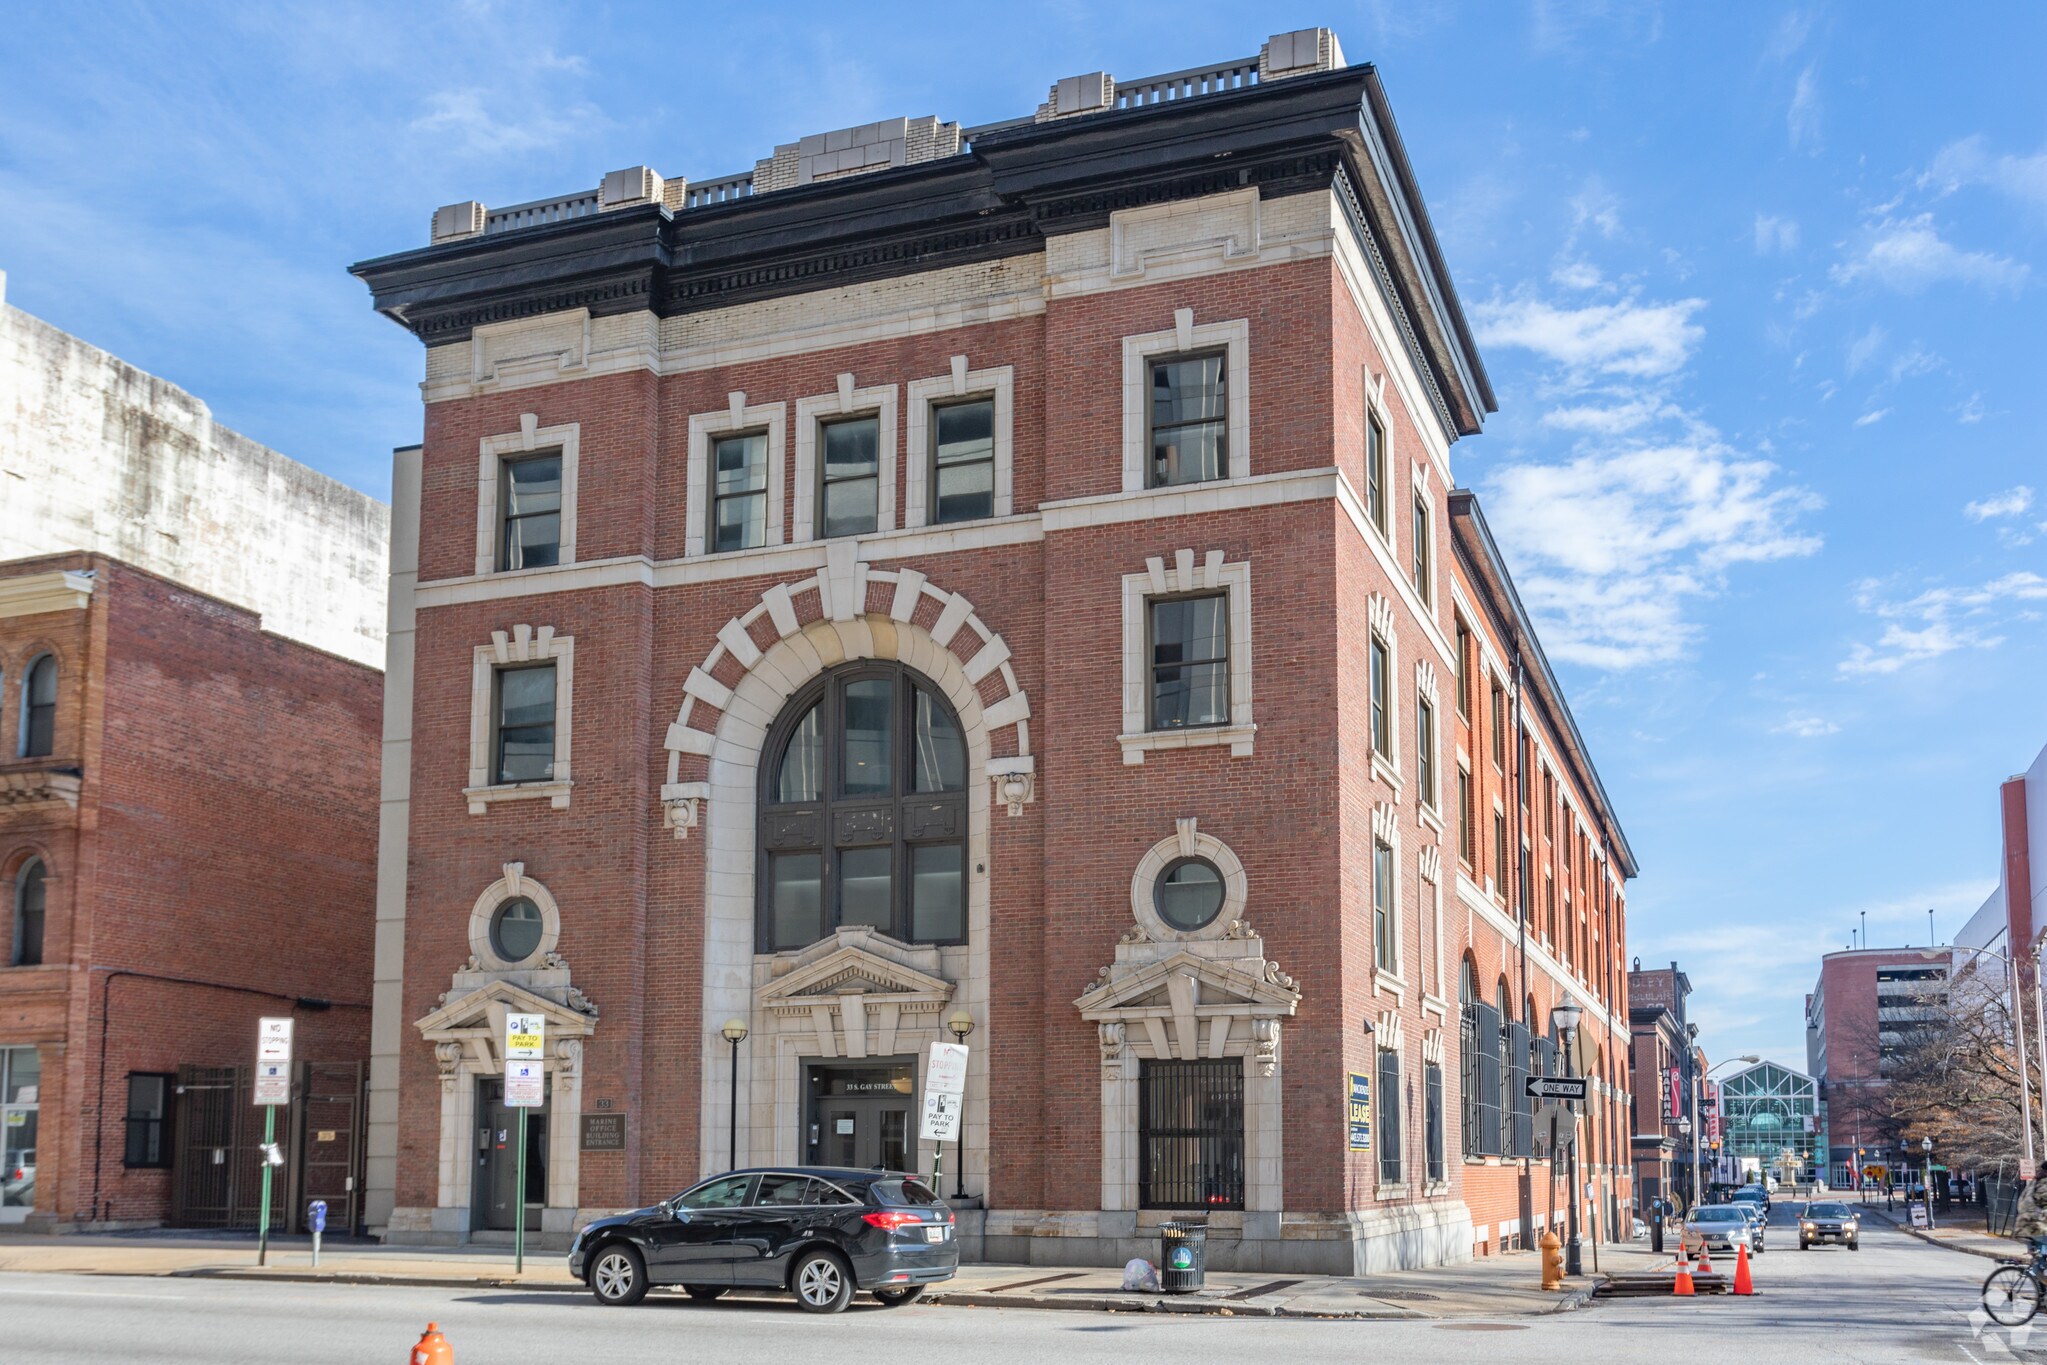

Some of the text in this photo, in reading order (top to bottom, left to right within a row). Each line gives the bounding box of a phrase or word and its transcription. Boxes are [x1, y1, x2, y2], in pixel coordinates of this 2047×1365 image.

[270, 1024, 281, 1033] NO
[262, 1036, 289, 1044] STOPPING
[1543, 1083, 1580, 1093] ONE WAY
[1662, 1069, 1671, 1117] HAVANA
[928, 1112, 943, 1120] PAY
[1350, 1102, 1370, 1123] LEASE
[930, 1119, 950, 1128] PARK
